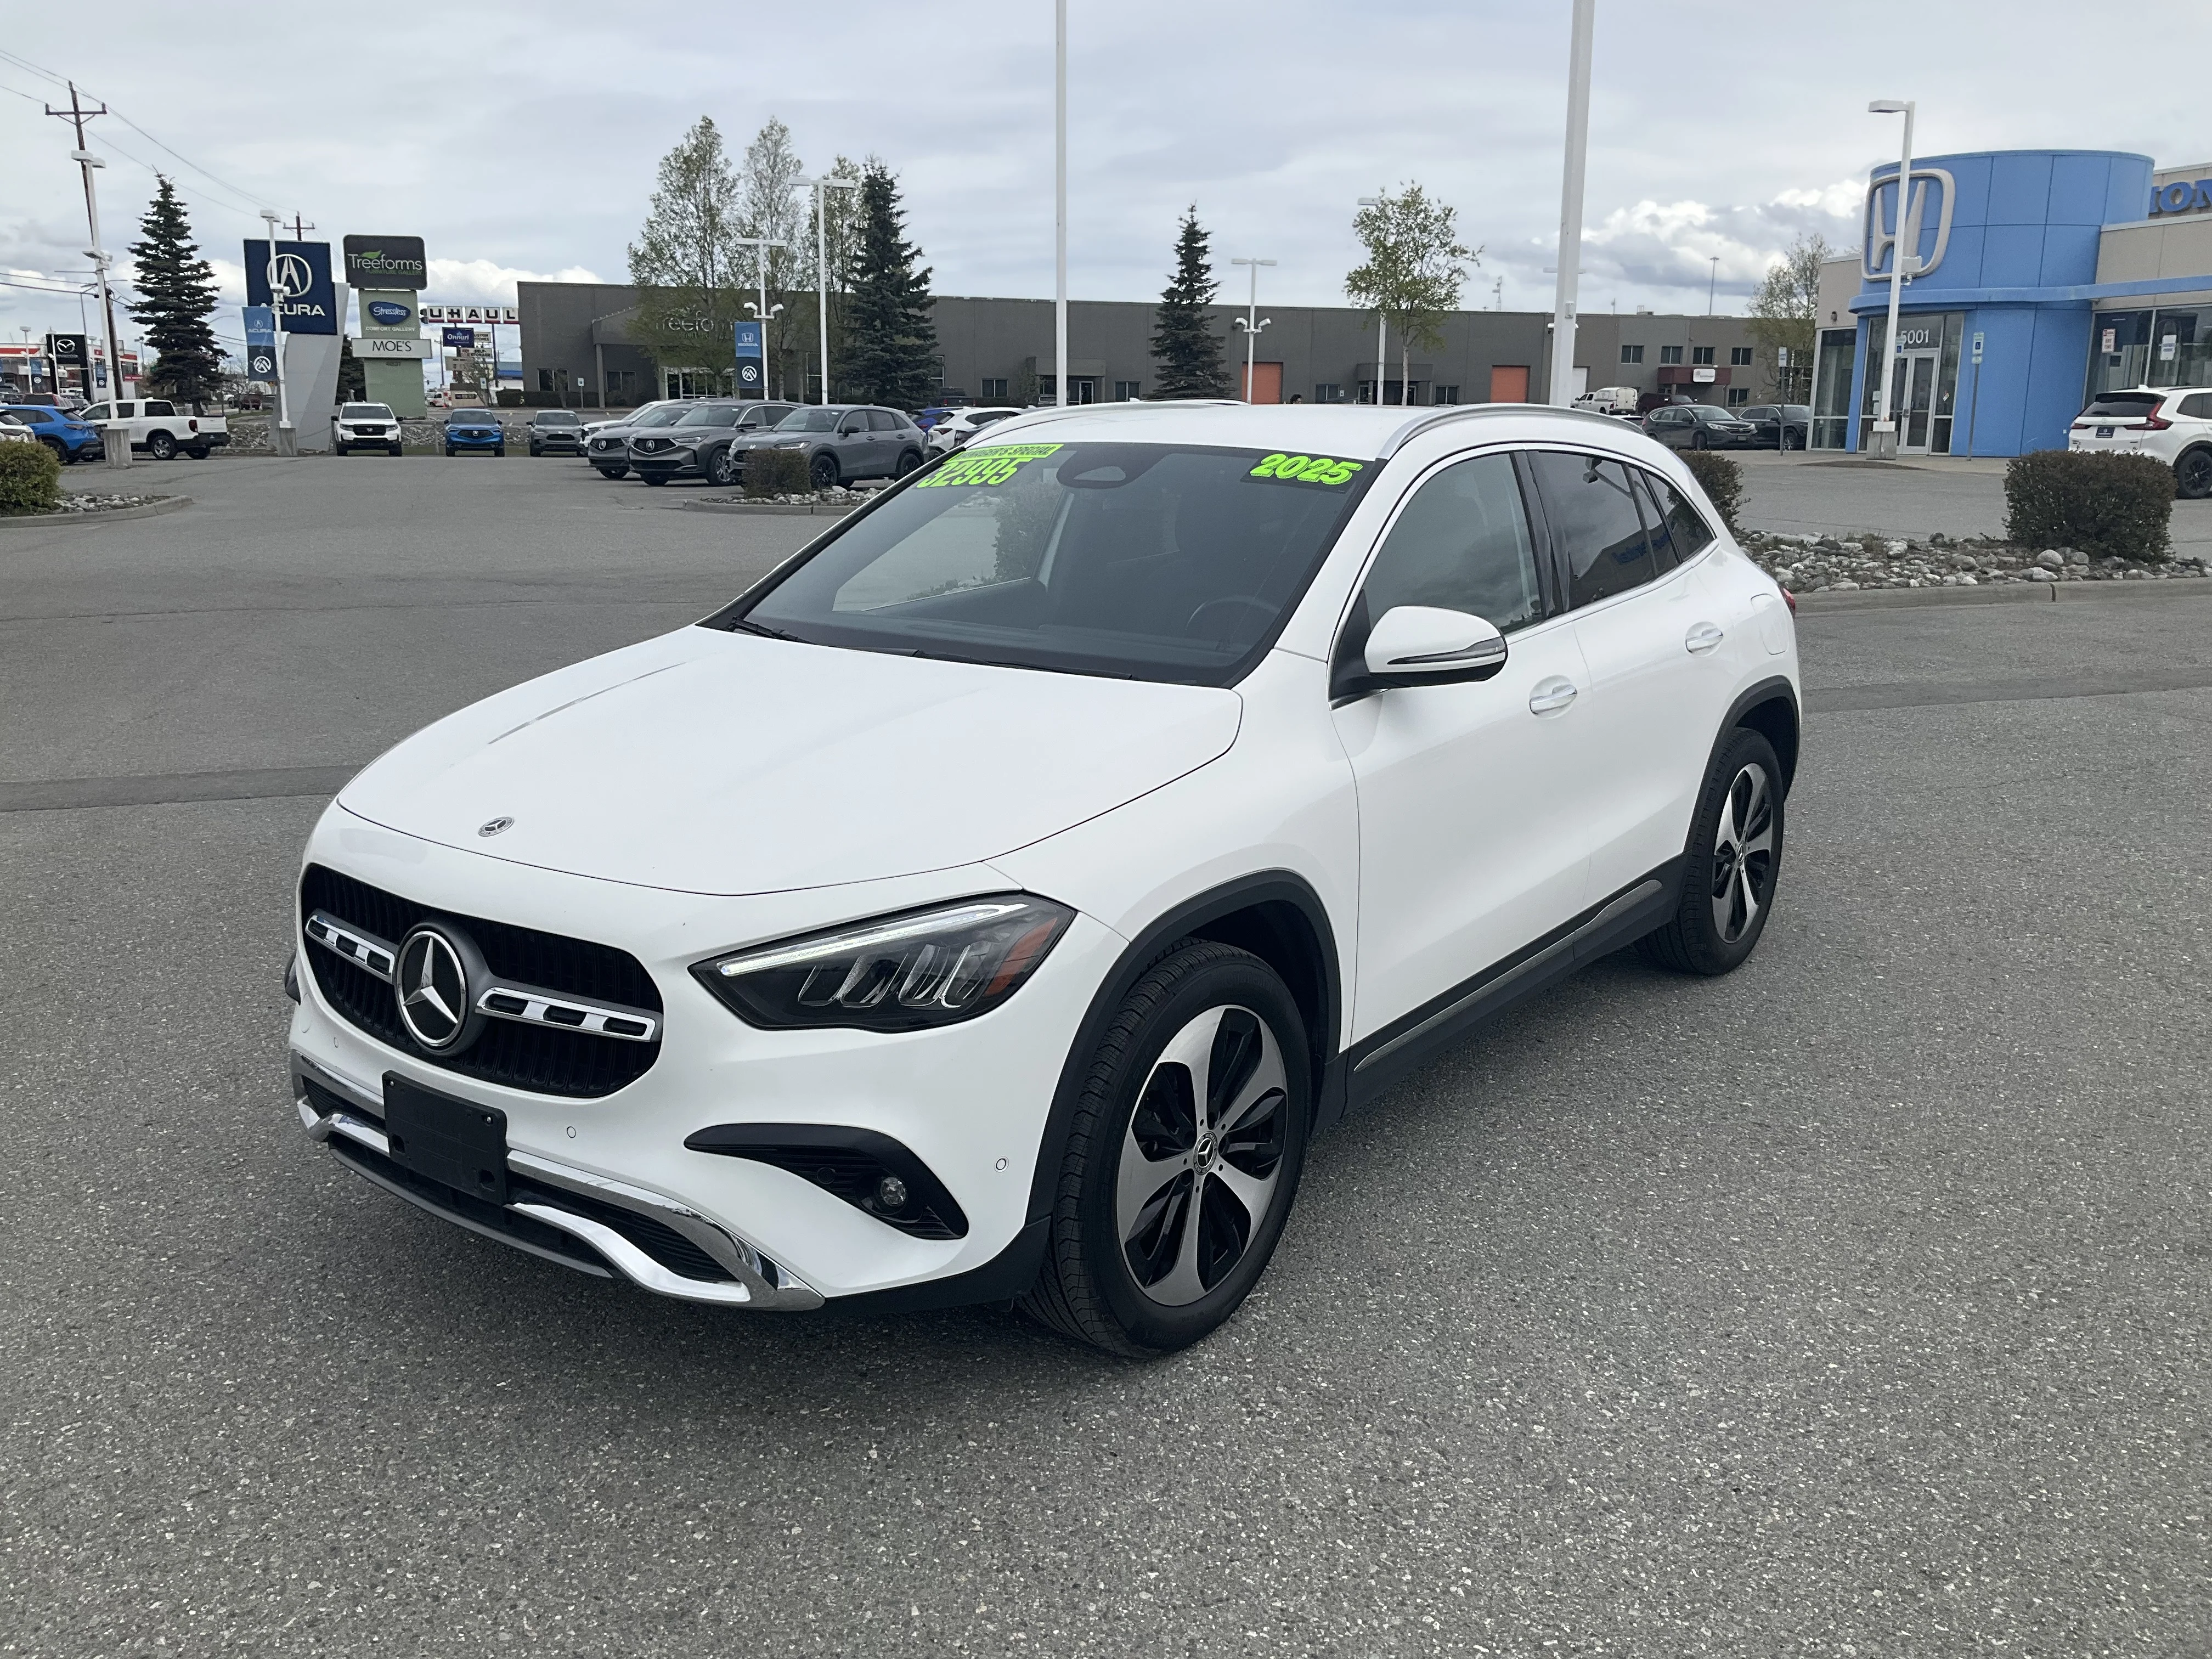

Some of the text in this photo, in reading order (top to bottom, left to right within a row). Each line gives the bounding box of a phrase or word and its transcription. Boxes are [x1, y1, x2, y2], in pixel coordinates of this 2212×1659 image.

[347, 253, 423, 270] Treeforms
[373, 307, 407, 316] Stressless
[1901, 329, 1929, 345] 5001
[372, 341, 412, 352] MOE'S
[916, 458, 1034, 488] 32995
[1249, 453, 1364, 485] 2025
